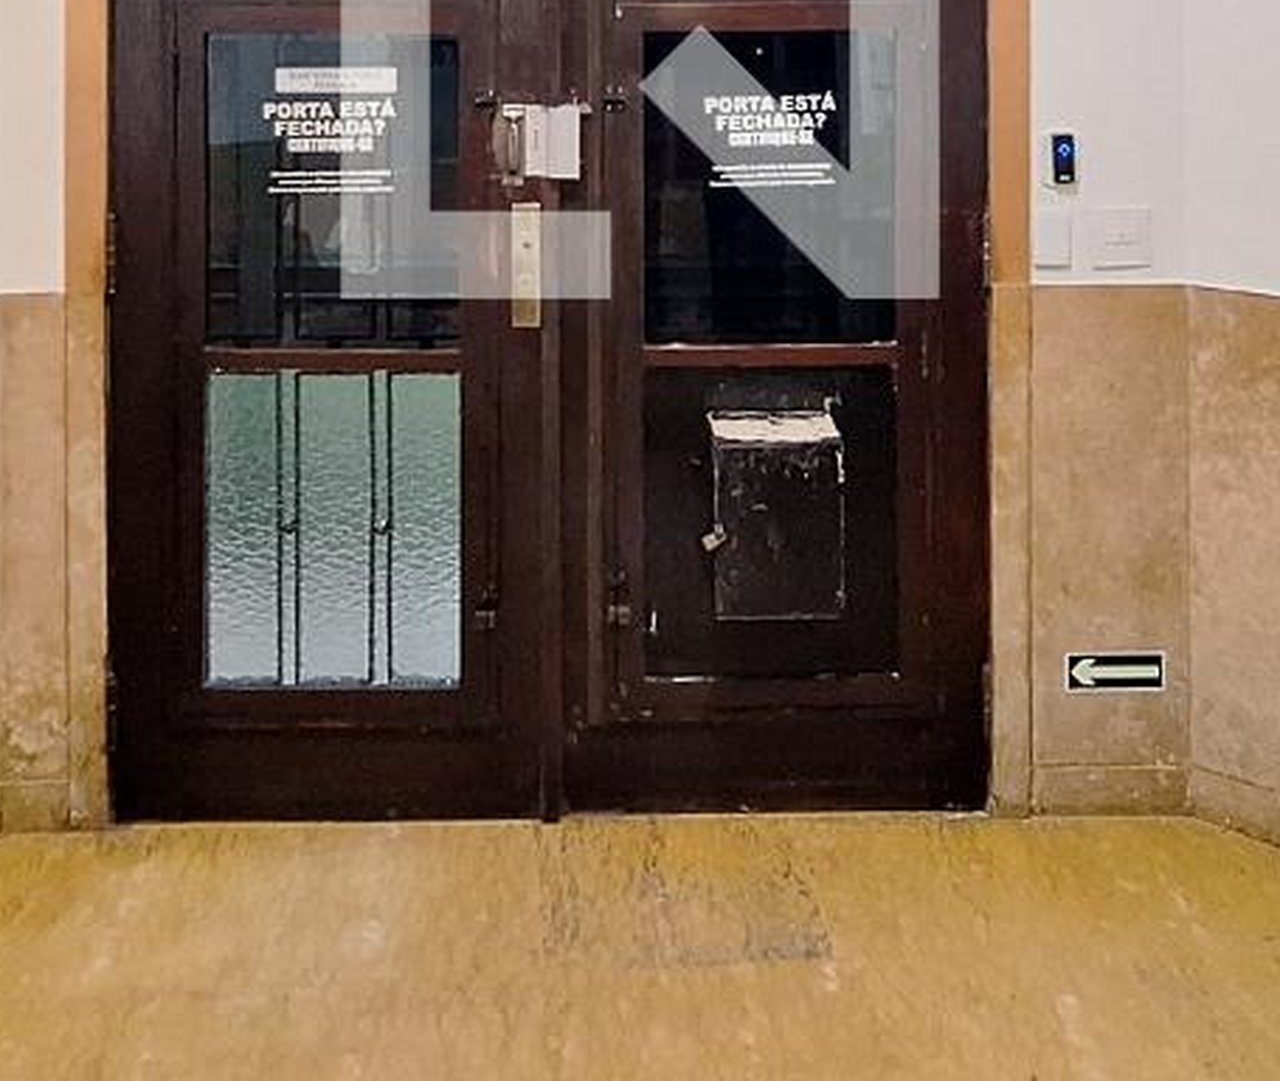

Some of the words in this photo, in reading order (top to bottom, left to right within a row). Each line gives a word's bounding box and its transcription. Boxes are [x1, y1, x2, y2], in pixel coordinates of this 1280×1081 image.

[263, 101, 335, 120] PORTA
[340, 97, 397, 118] ESTÁ
[704, 95, 775, 114] PORTA
[781, 90, 836, 112] ESTÁ
[275, 119, 386, 137] FECHADA?
[716, 113, 827, 131] FECHADA?
